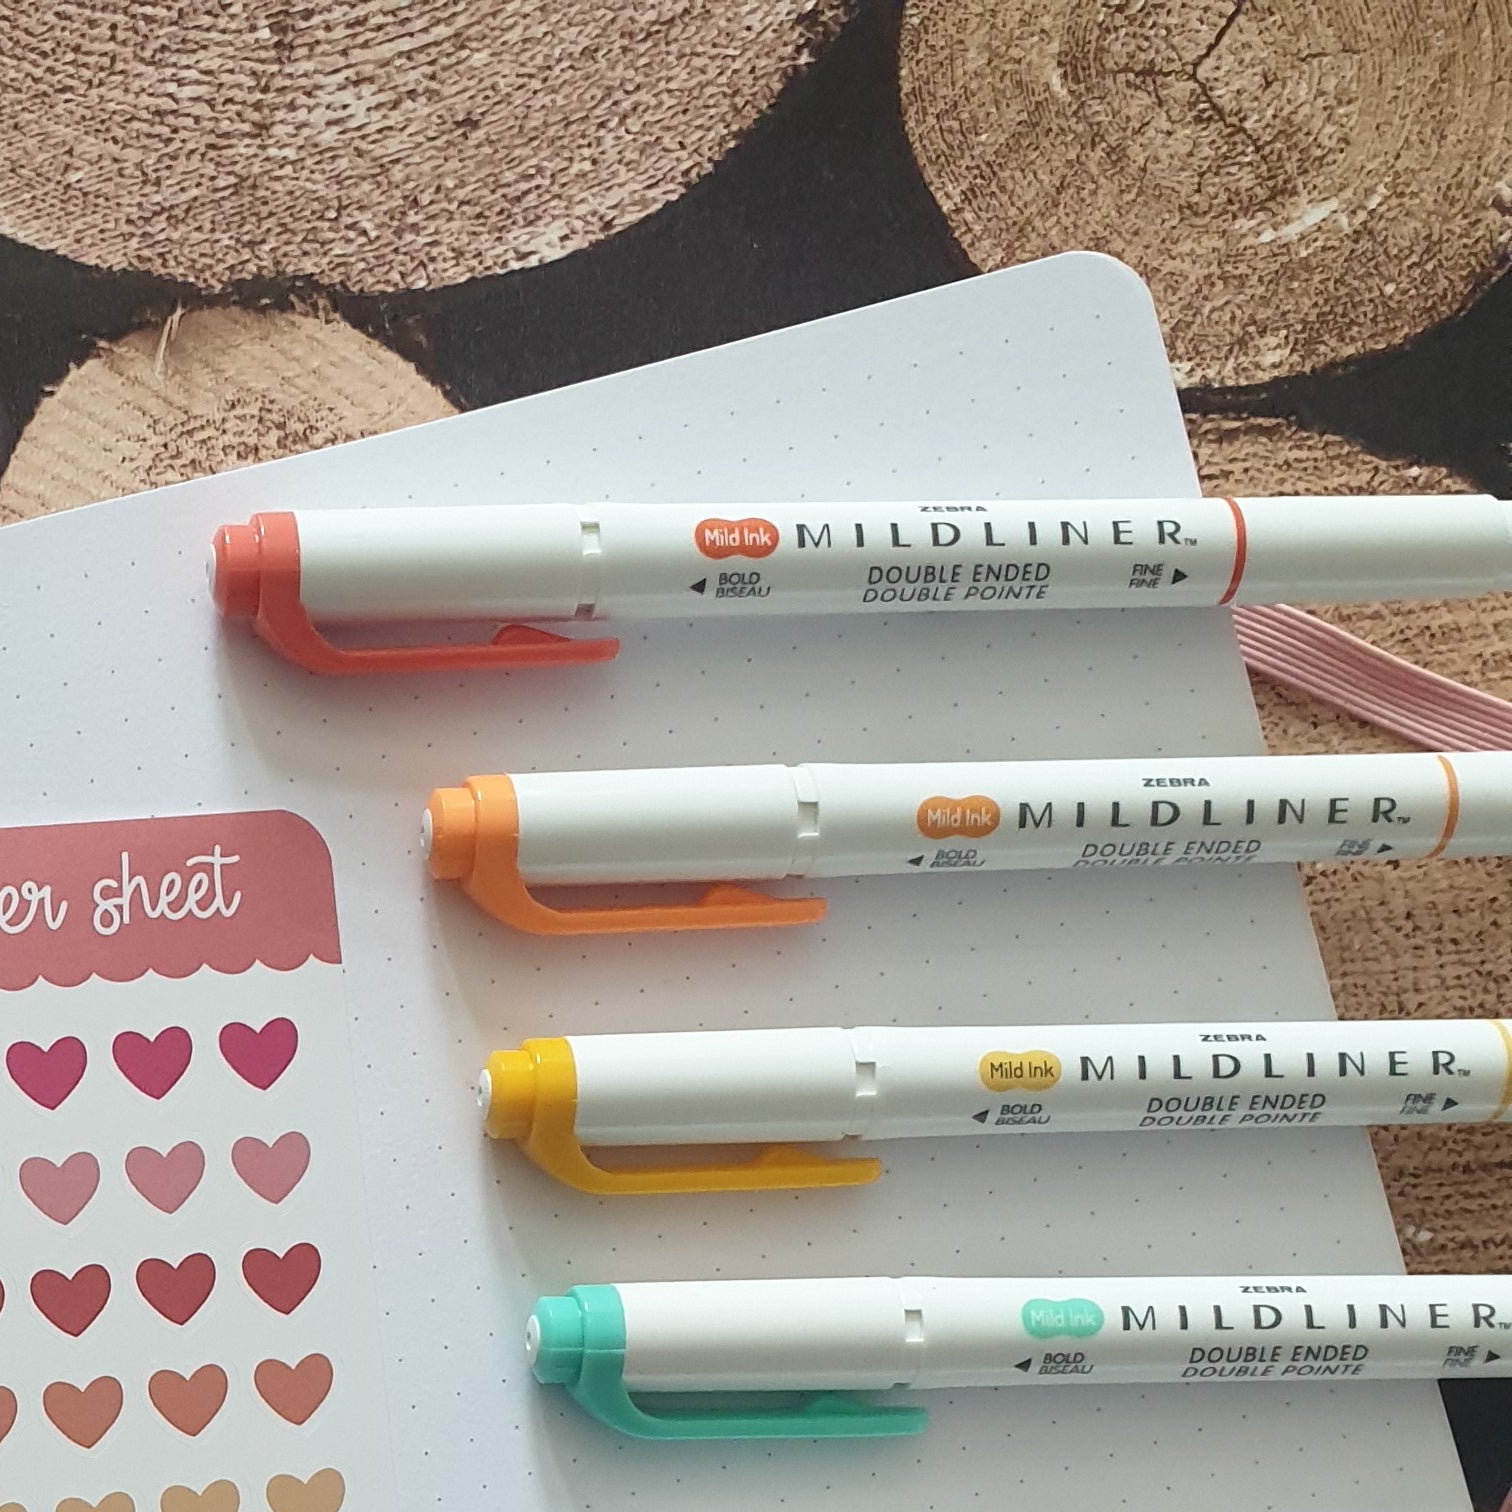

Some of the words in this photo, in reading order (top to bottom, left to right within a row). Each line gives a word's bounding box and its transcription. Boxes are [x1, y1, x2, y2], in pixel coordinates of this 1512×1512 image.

[919, 505, 988, 513] ZEBRA
[704, 527, 739, 547] Mild
[743, 527, 772, 546] Ink
[867, 564, 963, 585] DOUBLE
[972, 562, 1051, 583] ENDED
[1132, 563, 1165, 577] FINE
[718, 571, 761, 586] BOLD
[1127, 577, 1161, 589] FINE
[715, 586, 772, 599] BISEAU
[862, 586, 957, 603] DOUBLE
[963, 584, 1050, 600] POINTE
[1142, 777, 1211, 788] ZEBRA
[927, 808, 960, 828] Mild
[965, 807, 993, 827] Ink
[934, 849, 977, 861] BOLD
[1080, 841, 1176, 858] DOUBLE
[1183, 839, 1262, 855] ENDED
[92, 844, 242, 936] sheet
[1199, 1033, 1267, 1042] ZEBRA
[989, 1060, 1023, 1080] Mild
[1028, 1060, 1055, 1079] Ink
[1146, 1095, 1240, 1113] DOUBLE
[1248, 1093, 1326, 1111] ENDED
[1403, 1093, 1437, 1105] FINE
[999, 1103, 1043, 1116] BOLD
[994, 1114, 1052, 1126] BISEAU
[1138, 1114, 1232, 1127] DOUBLE
[1238, 1112, 1323, 1125] POINTE
[1239, 1285, 1308, 1294] ZEBRA
[1030, 1309, 1065, 1329] Mild
[1069, 1309, 1096, 1328] Ink
[1042, 1352, 1085, 1364] BOLD
[1188, 1346, 1283, 1364] DOUBLE
[1290, 1344, 1369, 1362] ENDED
[1445, 1345, 1480, 1357] FINE
[1038, 1364, 1095, 1376] BISEAU
[1180, 1365, 1275, 1378] DOUBLE
[1281, 1363, 1366, 1377] POINTE
